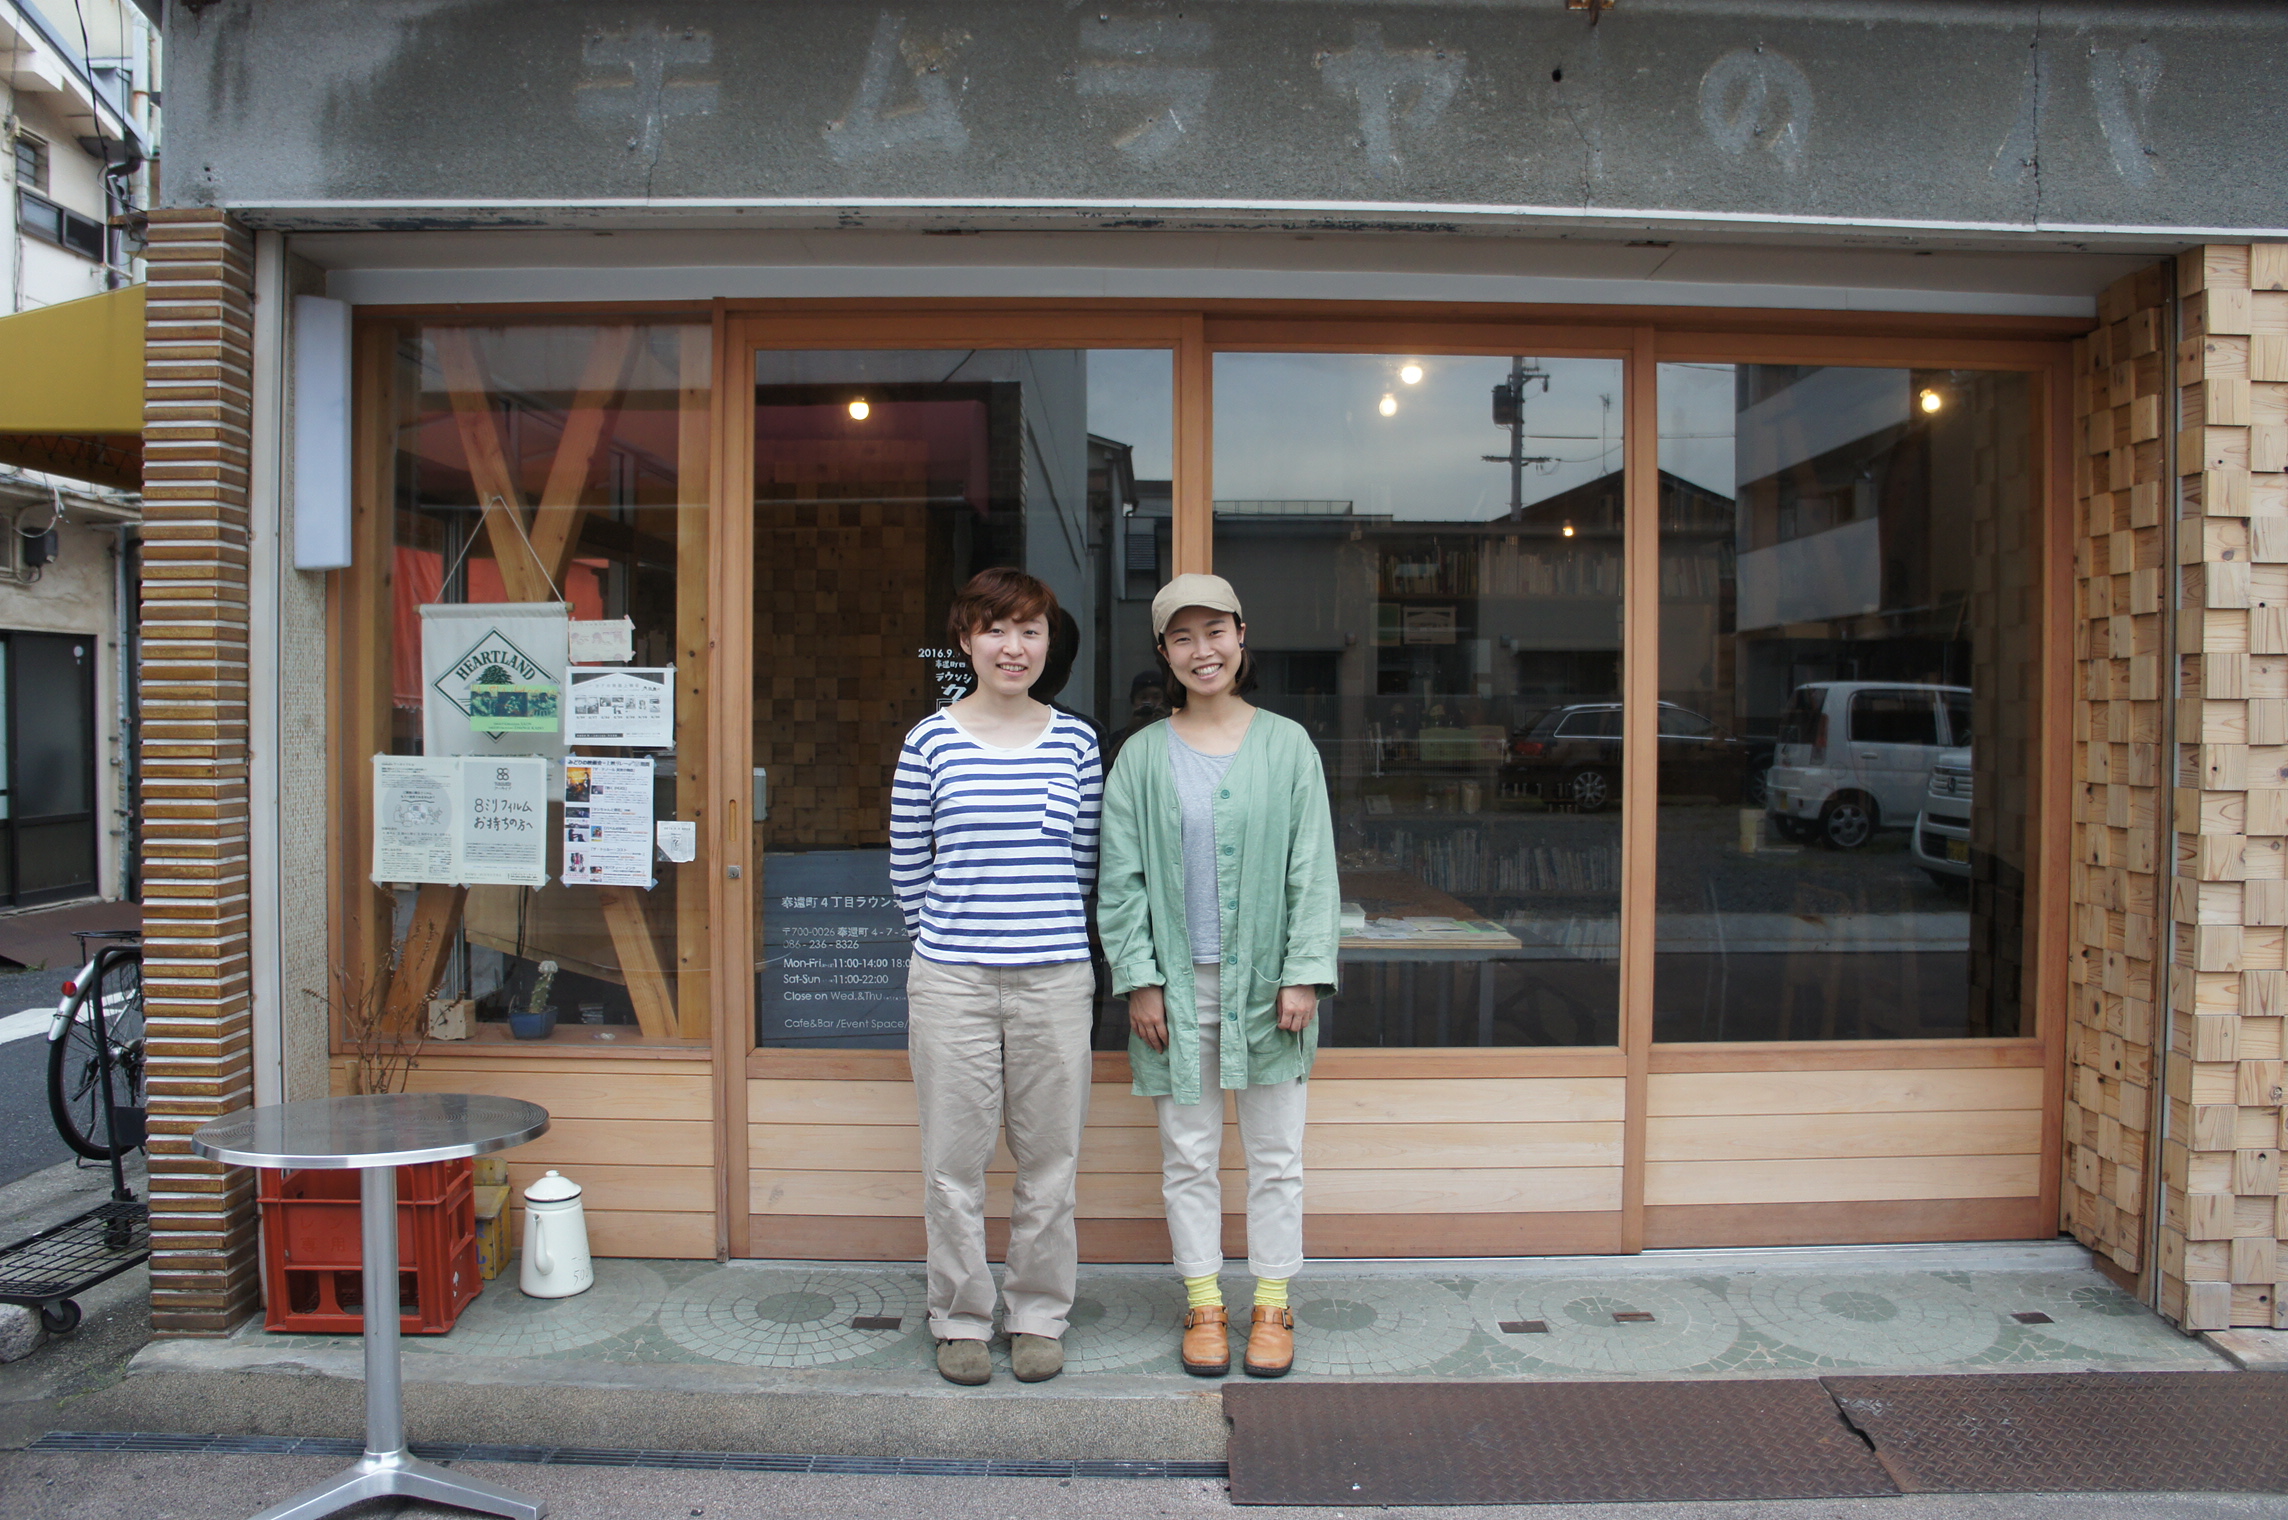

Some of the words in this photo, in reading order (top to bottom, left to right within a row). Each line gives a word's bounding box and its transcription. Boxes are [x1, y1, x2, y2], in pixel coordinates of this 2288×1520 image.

[455, 650, 536, 681] HEARTLAND
[474, 798, 533, 813] 8ミリフィルム
[473, 816, 533, 832] お持ちの方へ
[837, 926, 868, 938] 奉還町
[833, 958, 888, 968] 11:00-14:00
[783, 974, 821, 984] Sat-Sun
[833, 974, 889, 984] 11:00-22:00
[783, 991, 812, 1001] Close
[814, 993, 828, 1001] on
[830, 991, 882, 1001] Wed.&Thu
[784, 1018, 834, 1029] Cafe&Bar
